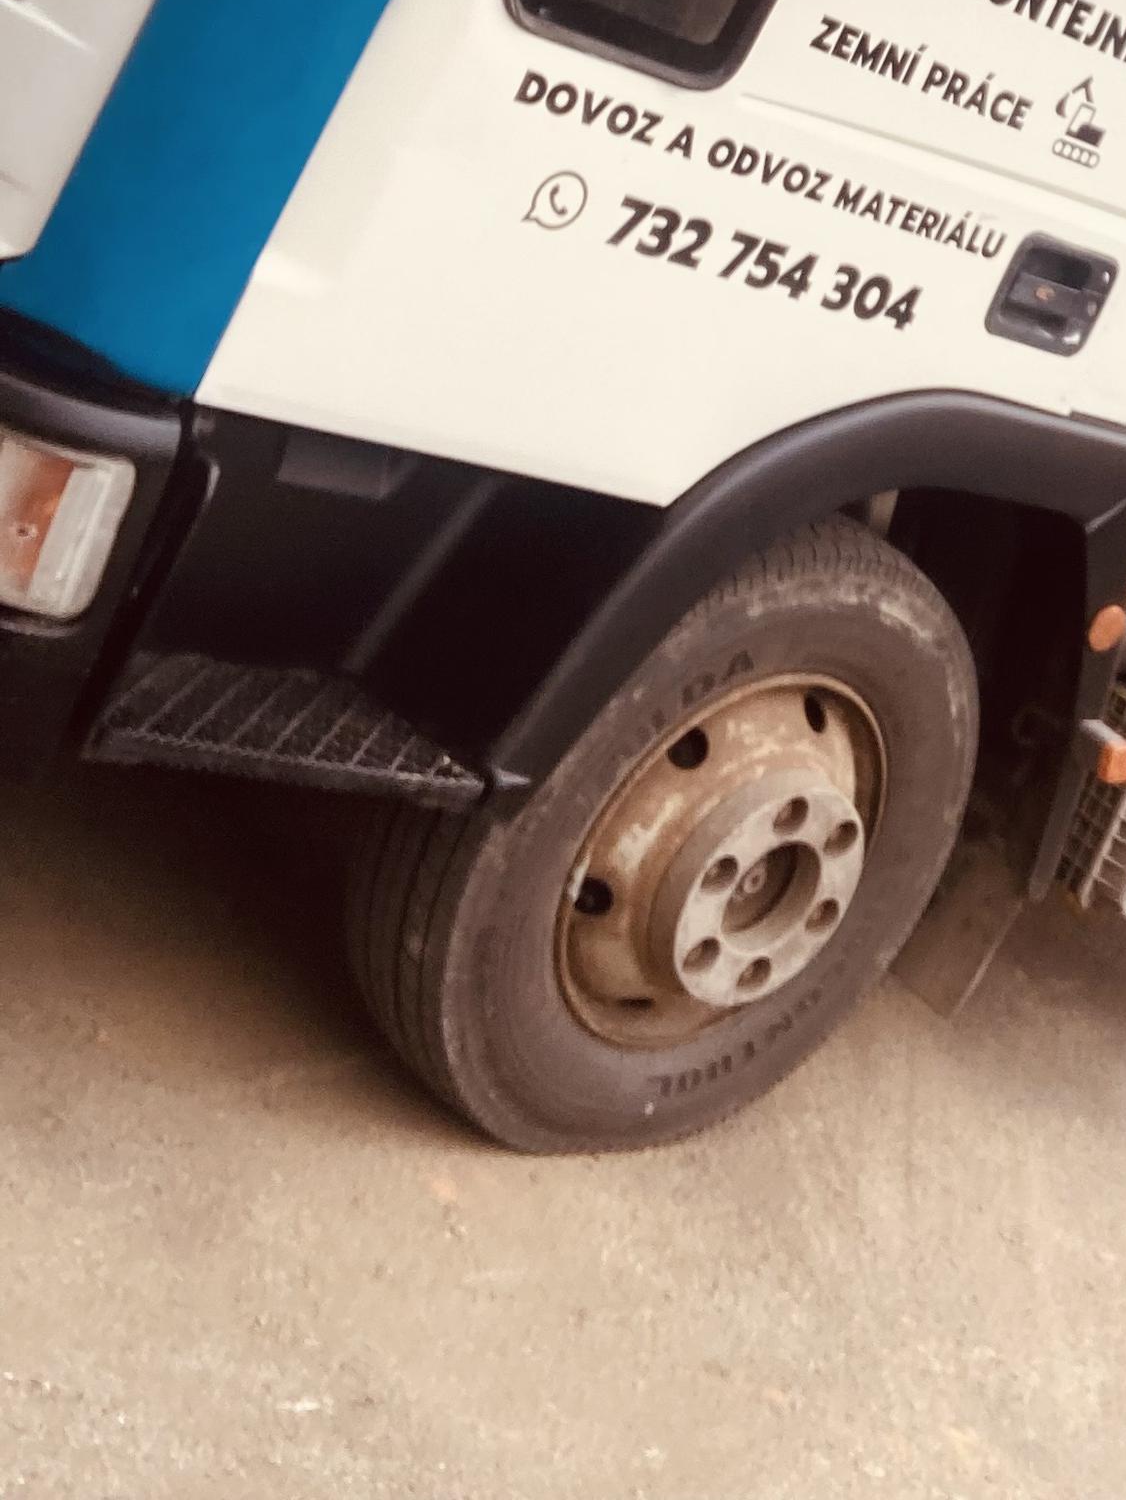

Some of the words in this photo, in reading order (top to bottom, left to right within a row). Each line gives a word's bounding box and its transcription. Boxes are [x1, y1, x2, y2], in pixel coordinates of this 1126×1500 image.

[808, 15, 926, 86] ZEMNÍ
[920, 60, 1033, 130] PRÁCE
[513, 70, 663, 145] DOVOZ
[664, 125, 694, 159] A
[706, 138, 832, 202] ODVOZ
[832, 179, 1007, 260] MATERIÁLU
[606, 196, 713, 269] 732
[718, 231, 818, 299] 754
[819, 265, 923, 330] 304
